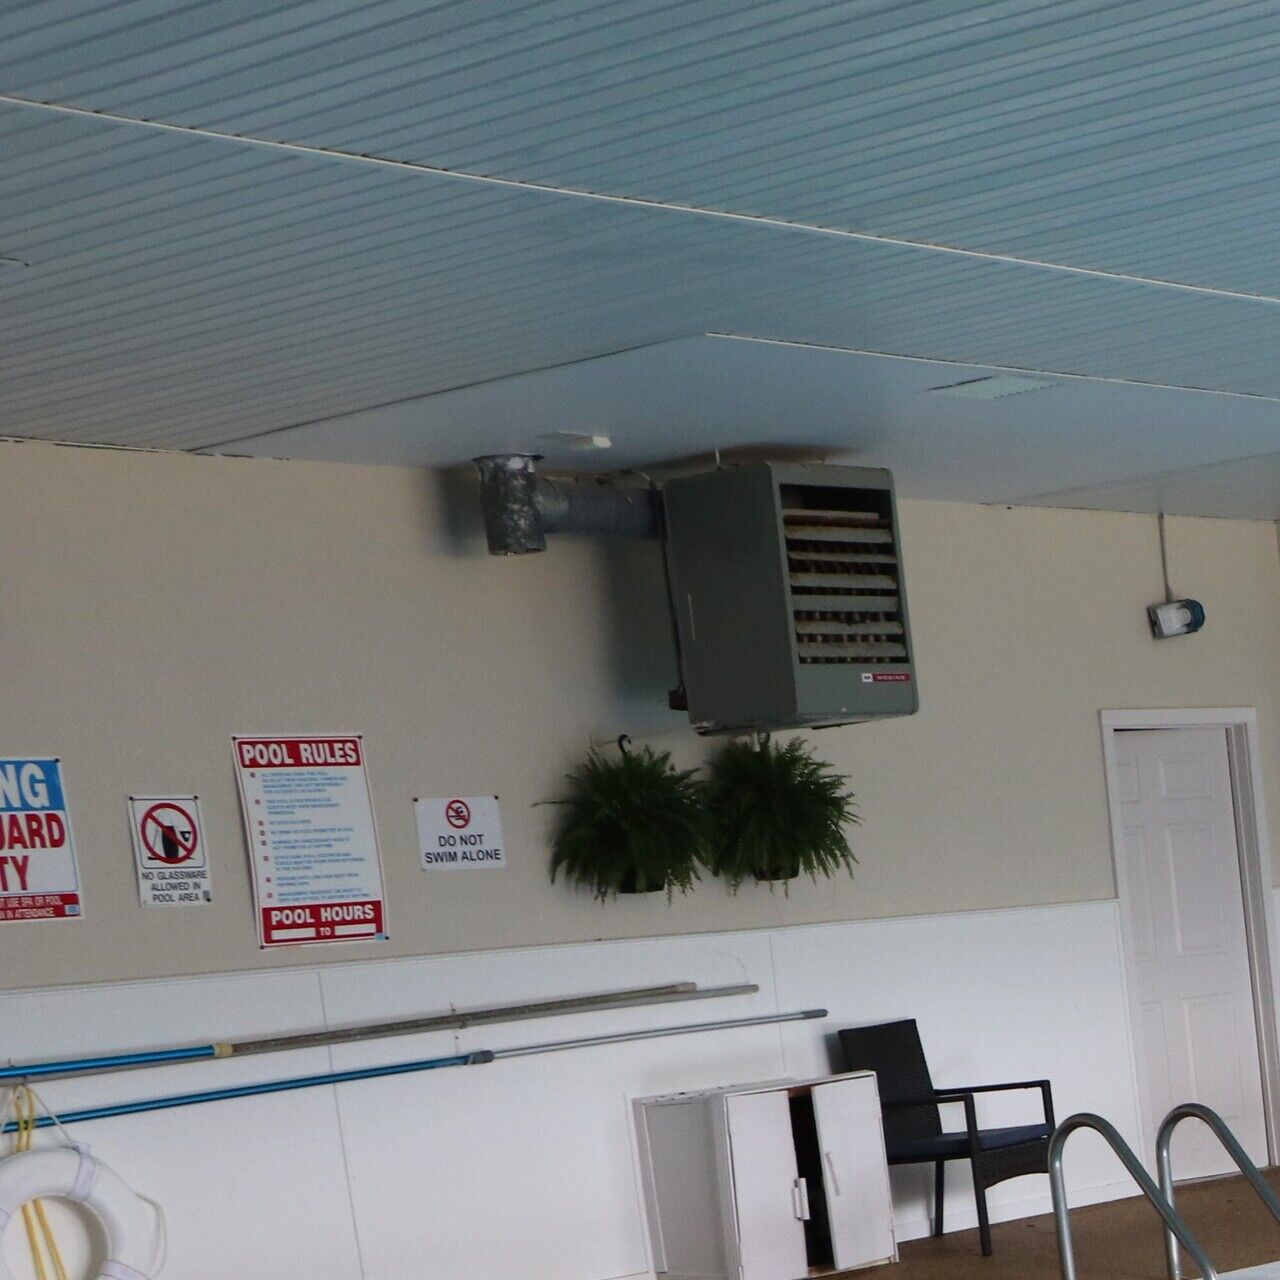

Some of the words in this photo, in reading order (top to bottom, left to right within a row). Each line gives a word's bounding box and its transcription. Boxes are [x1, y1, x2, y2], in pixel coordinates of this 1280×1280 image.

[241, 743, 295, 766] POOL
[299, 741, 359, 764] RULES
[438, 835, 456, 847] DO
[460, 834, 484, 846] NOT
[425, 851, 458, 863] SWIM
[461, 849, 501, 862] ALONE
[142, 872, 154, 880] NO
[157, 870, 207, 880] GLASSWARE
[151, 883, 189, 891] ALLOWED
[194, 881, 201, 890] IN
[153, 893, 175, 903] POOL
[178, 892, 200, 902] AREA
[271, 909, 315, 926] POOL
[320, 904, 375, 922] HOURS
[319, 927, 332, 936] TO
